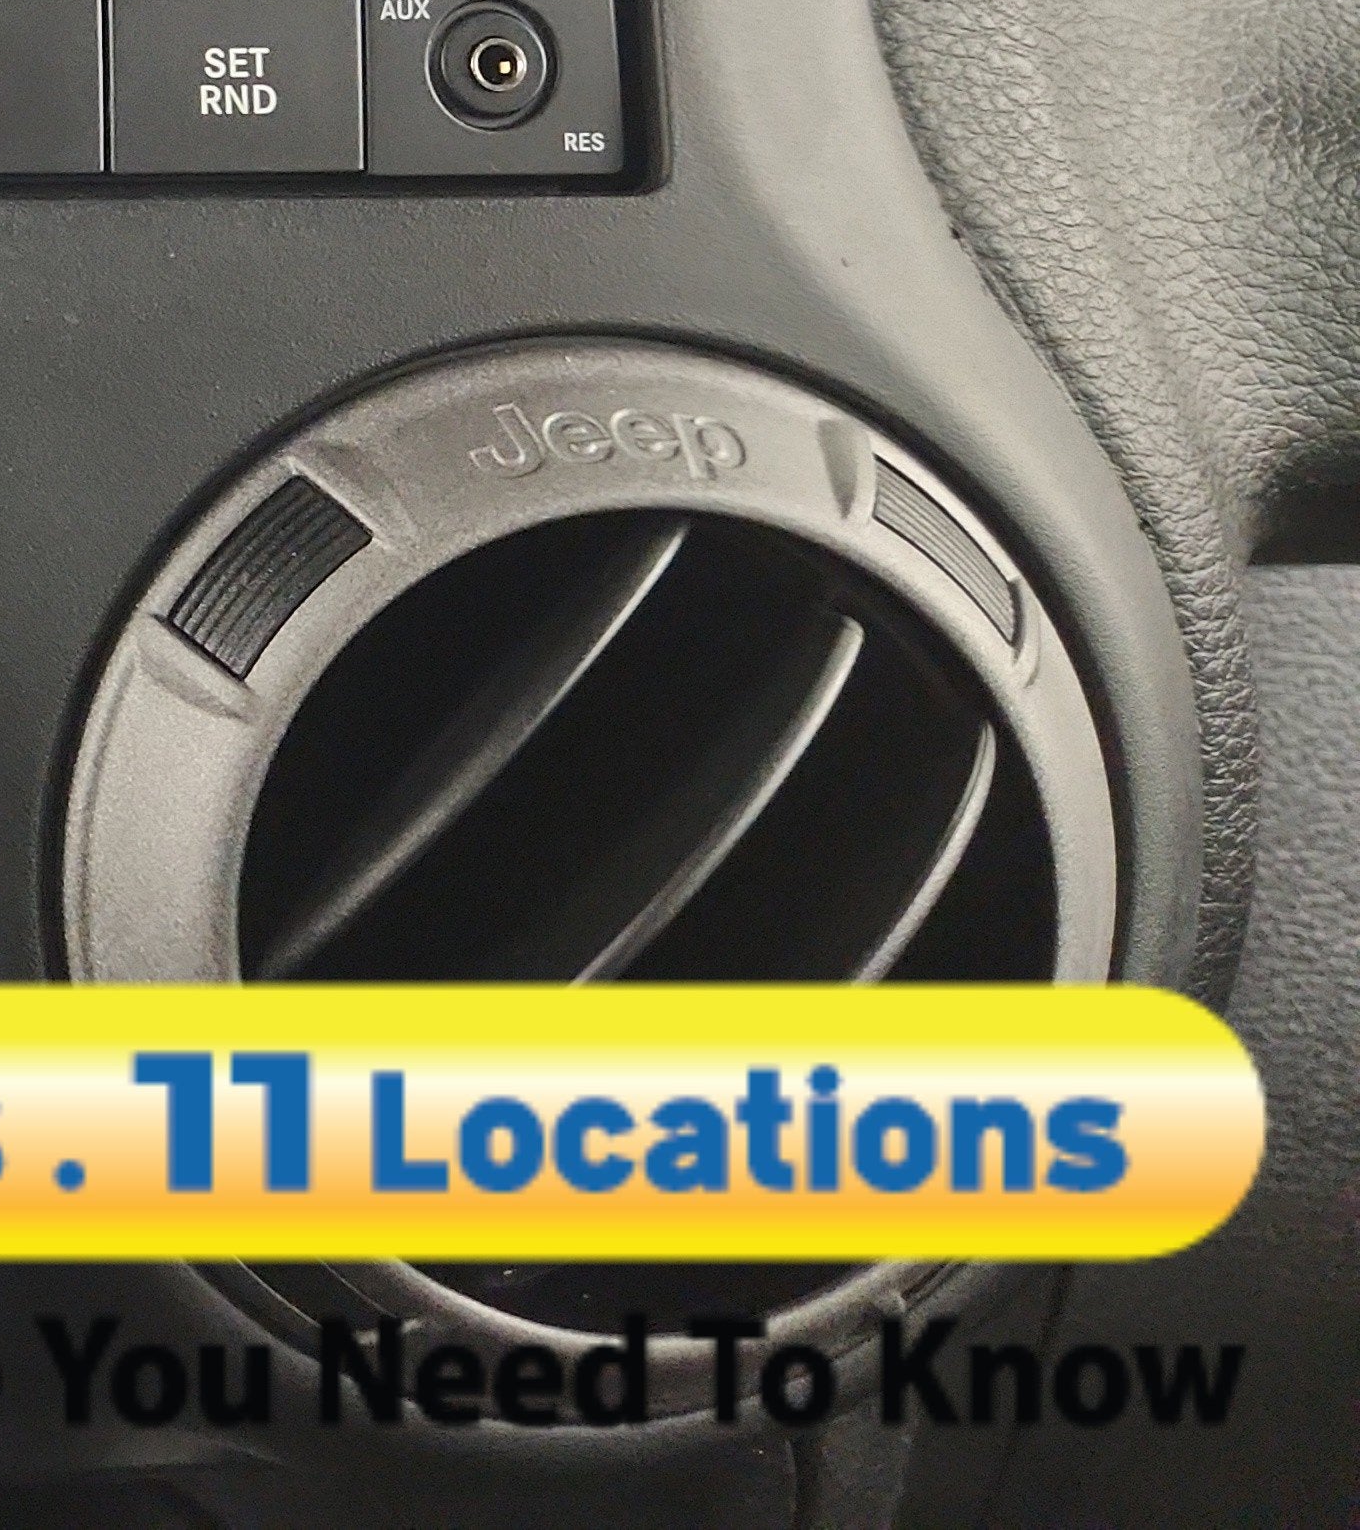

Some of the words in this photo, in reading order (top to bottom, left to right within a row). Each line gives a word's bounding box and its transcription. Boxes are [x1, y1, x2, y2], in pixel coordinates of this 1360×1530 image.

[204, 47, 270, 79] SET
[200, 84, 278, 115] RND
[563, 132, 605, 152] RES
[469, 403, 747, 480] Jeep
